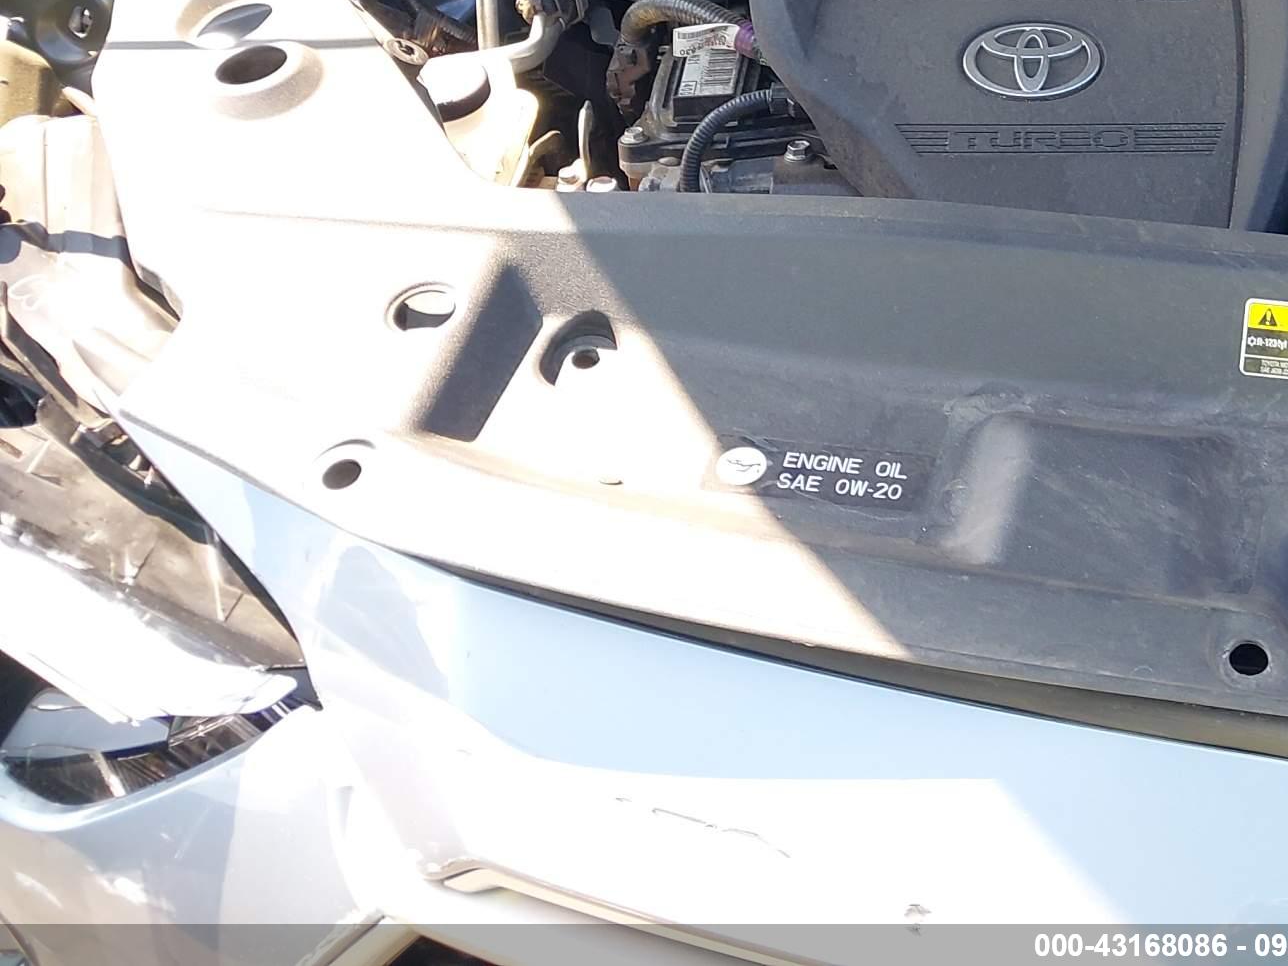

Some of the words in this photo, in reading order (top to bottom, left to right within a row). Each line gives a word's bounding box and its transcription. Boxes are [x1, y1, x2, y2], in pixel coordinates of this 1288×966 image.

[783, 452, 863, 474] ENGINE
[875, 461, 907, 479] OIL
[777, 473, 823, 492] SAE
[835, 479, 902, 499] 0W-20
